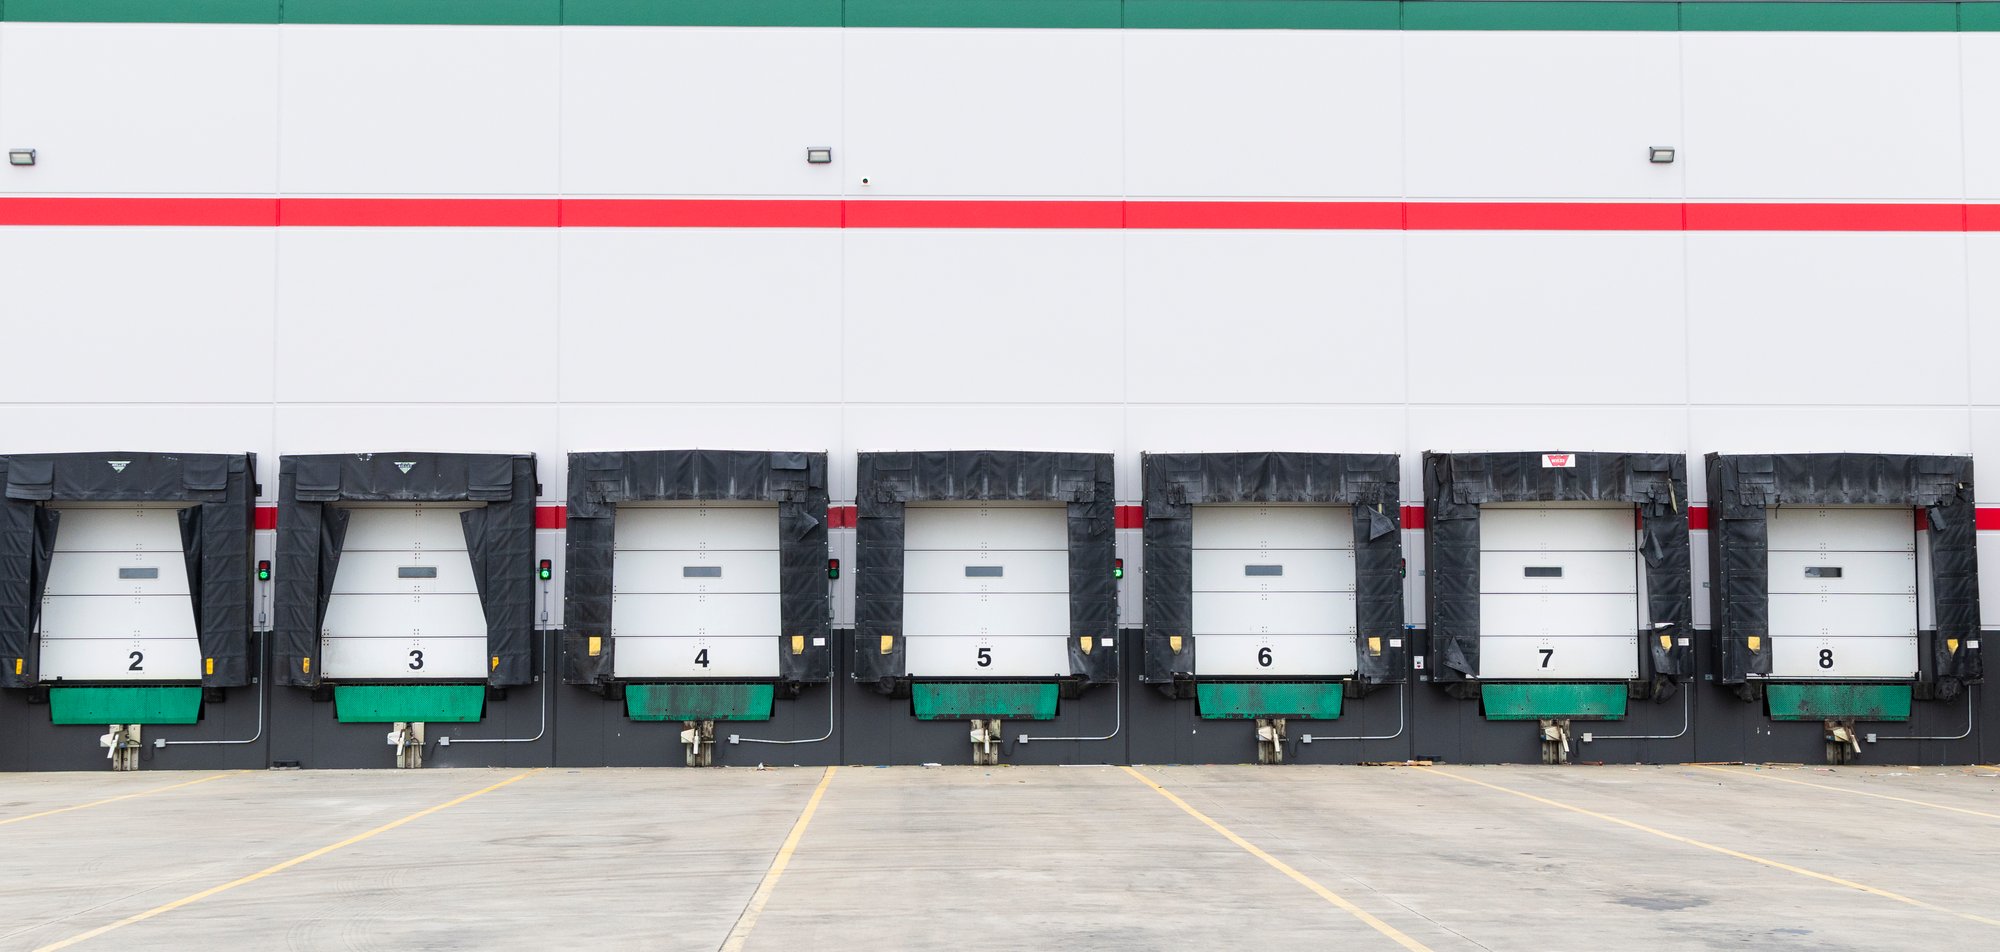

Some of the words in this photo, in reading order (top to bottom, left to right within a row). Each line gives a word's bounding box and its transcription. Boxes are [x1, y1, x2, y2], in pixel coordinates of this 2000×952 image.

[129, 651, 143, 670] 2
[409, 650, 423, 669] 3
[694, 649, 709, 667] 4
[977, 648, 991, 667] 5
[1258, 648, 1272, 666] 6
[1539, 649, 1553, 667] 7
[1818, 649, 1833, 668] 8
